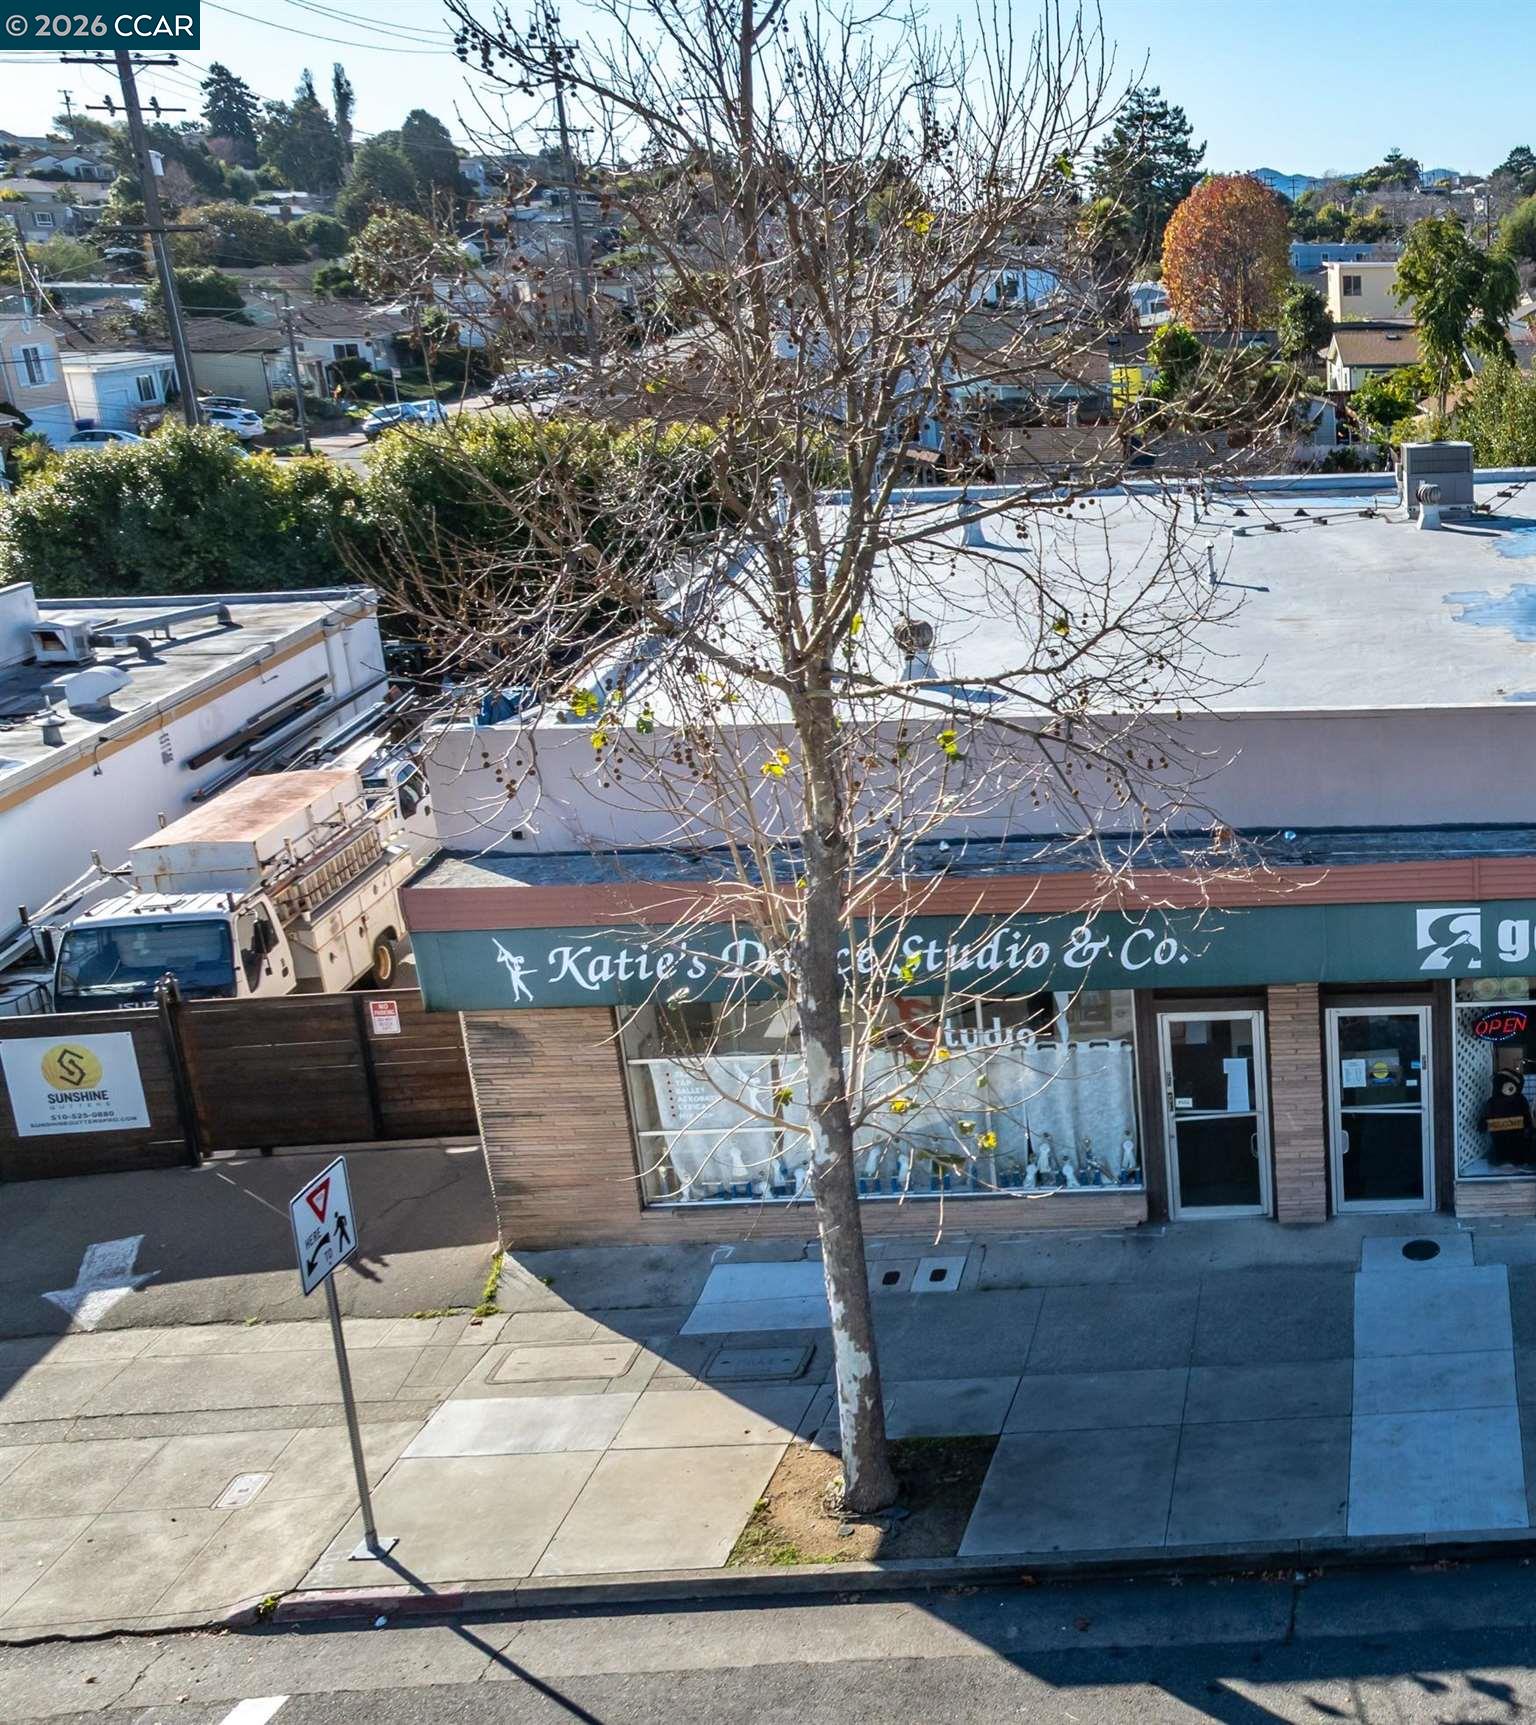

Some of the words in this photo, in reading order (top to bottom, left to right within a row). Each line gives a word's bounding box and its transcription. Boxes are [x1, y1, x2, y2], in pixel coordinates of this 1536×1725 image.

[547, 942, 707, 991] Katie's
[892, 927, 1050, 974] Studio
[1062, 925, 1110, 969] &
[1119, 927, 1189, 971] Co.
[1475, 1017, 1528, 1036] OPEN
[47, 1090, 110, 1105] SUNSHINE
[304, 1226, 322, 1250] HERE
